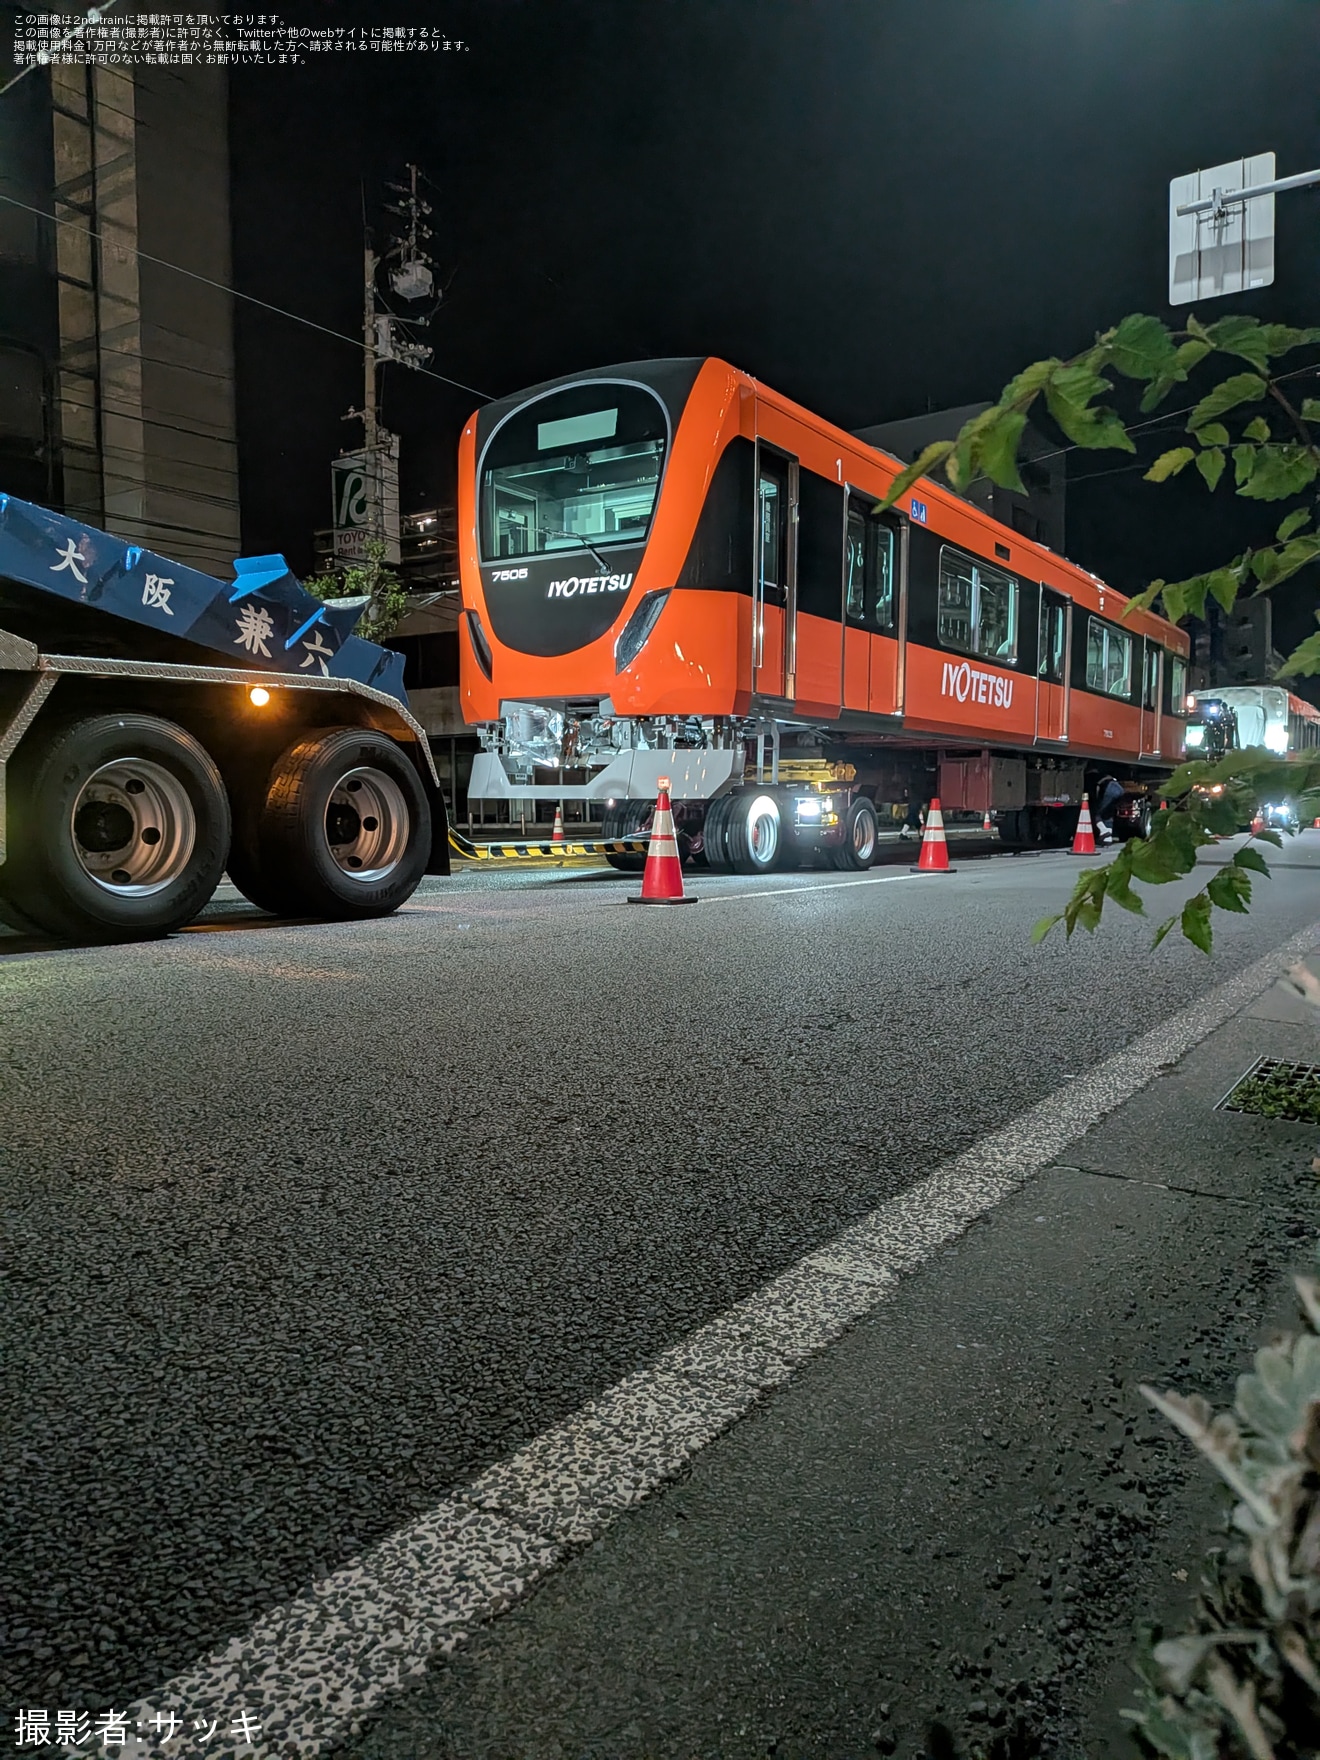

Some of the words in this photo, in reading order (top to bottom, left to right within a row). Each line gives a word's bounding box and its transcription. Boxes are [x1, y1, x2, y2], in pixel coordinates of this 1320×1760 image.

[836, 458, 842, 481] 1
[491, 568, 529, 582] 7505
[547, 572, 633, 598] IYOTETSU
[941, 662, 1013, 709] IYOTETSU
